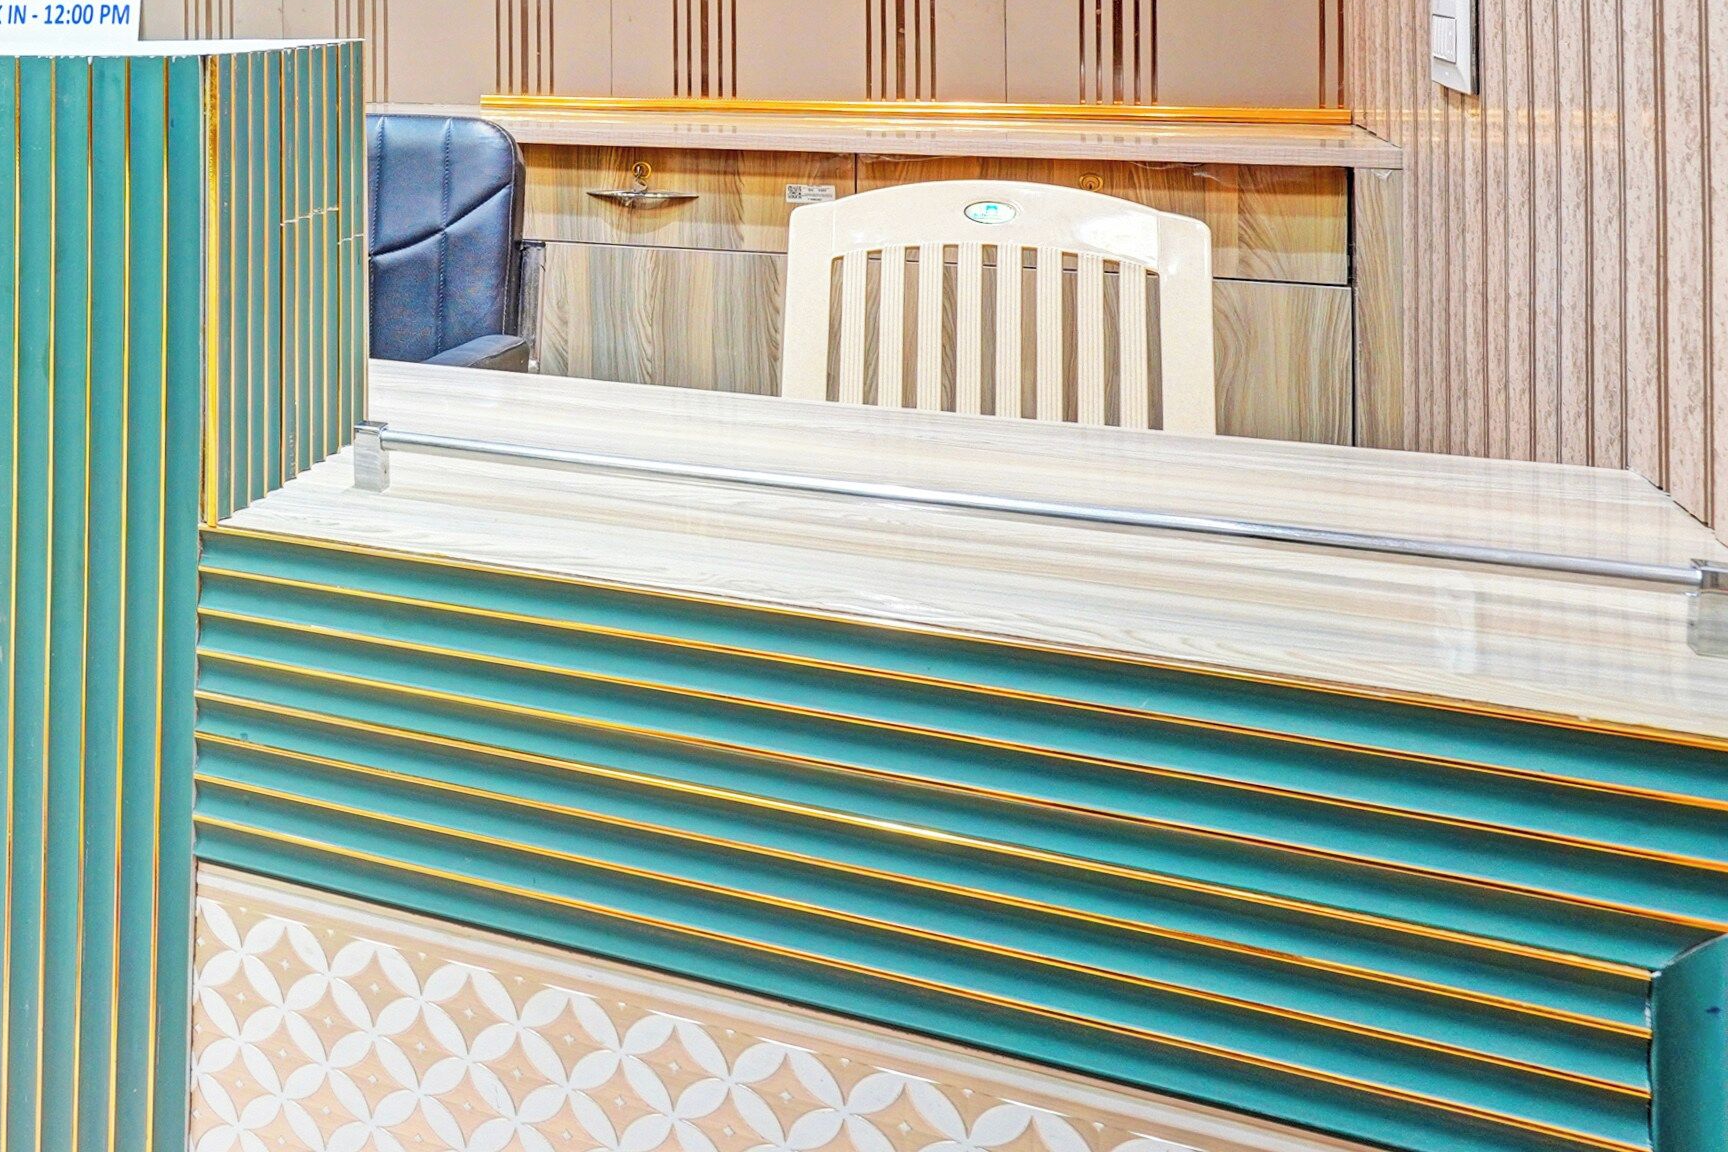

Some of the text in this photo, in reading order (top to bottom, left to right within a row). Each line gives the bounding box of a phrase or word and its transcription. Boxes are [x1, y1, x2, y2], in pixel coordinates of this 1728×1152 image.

[8, 4, 27, 25] IN
[43, 3, 94, 25] 12:00
[99, 3, 131, 25] PM
